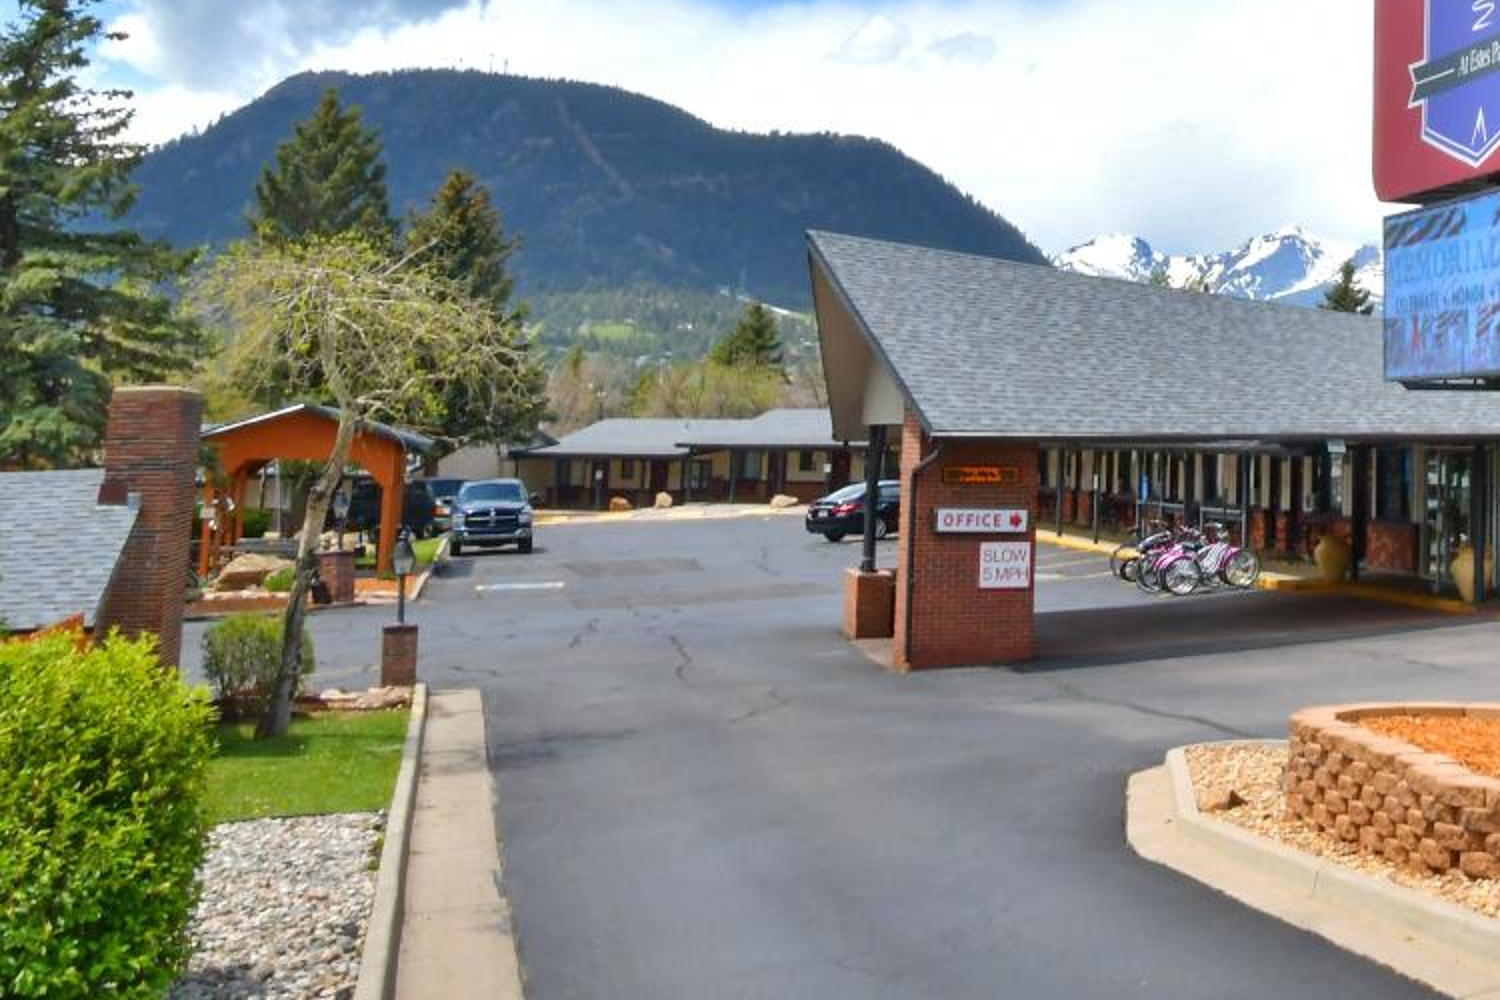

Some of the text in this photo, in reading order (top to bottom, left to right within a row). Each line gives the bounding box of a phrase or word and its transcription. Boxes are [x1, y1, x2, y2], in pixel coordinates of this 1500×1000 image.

[943, 513, 1003, 528] OFFICE
[983, 549, 1027, 563] SLOW
[983, 566, 1029, 581] 5 MPH
